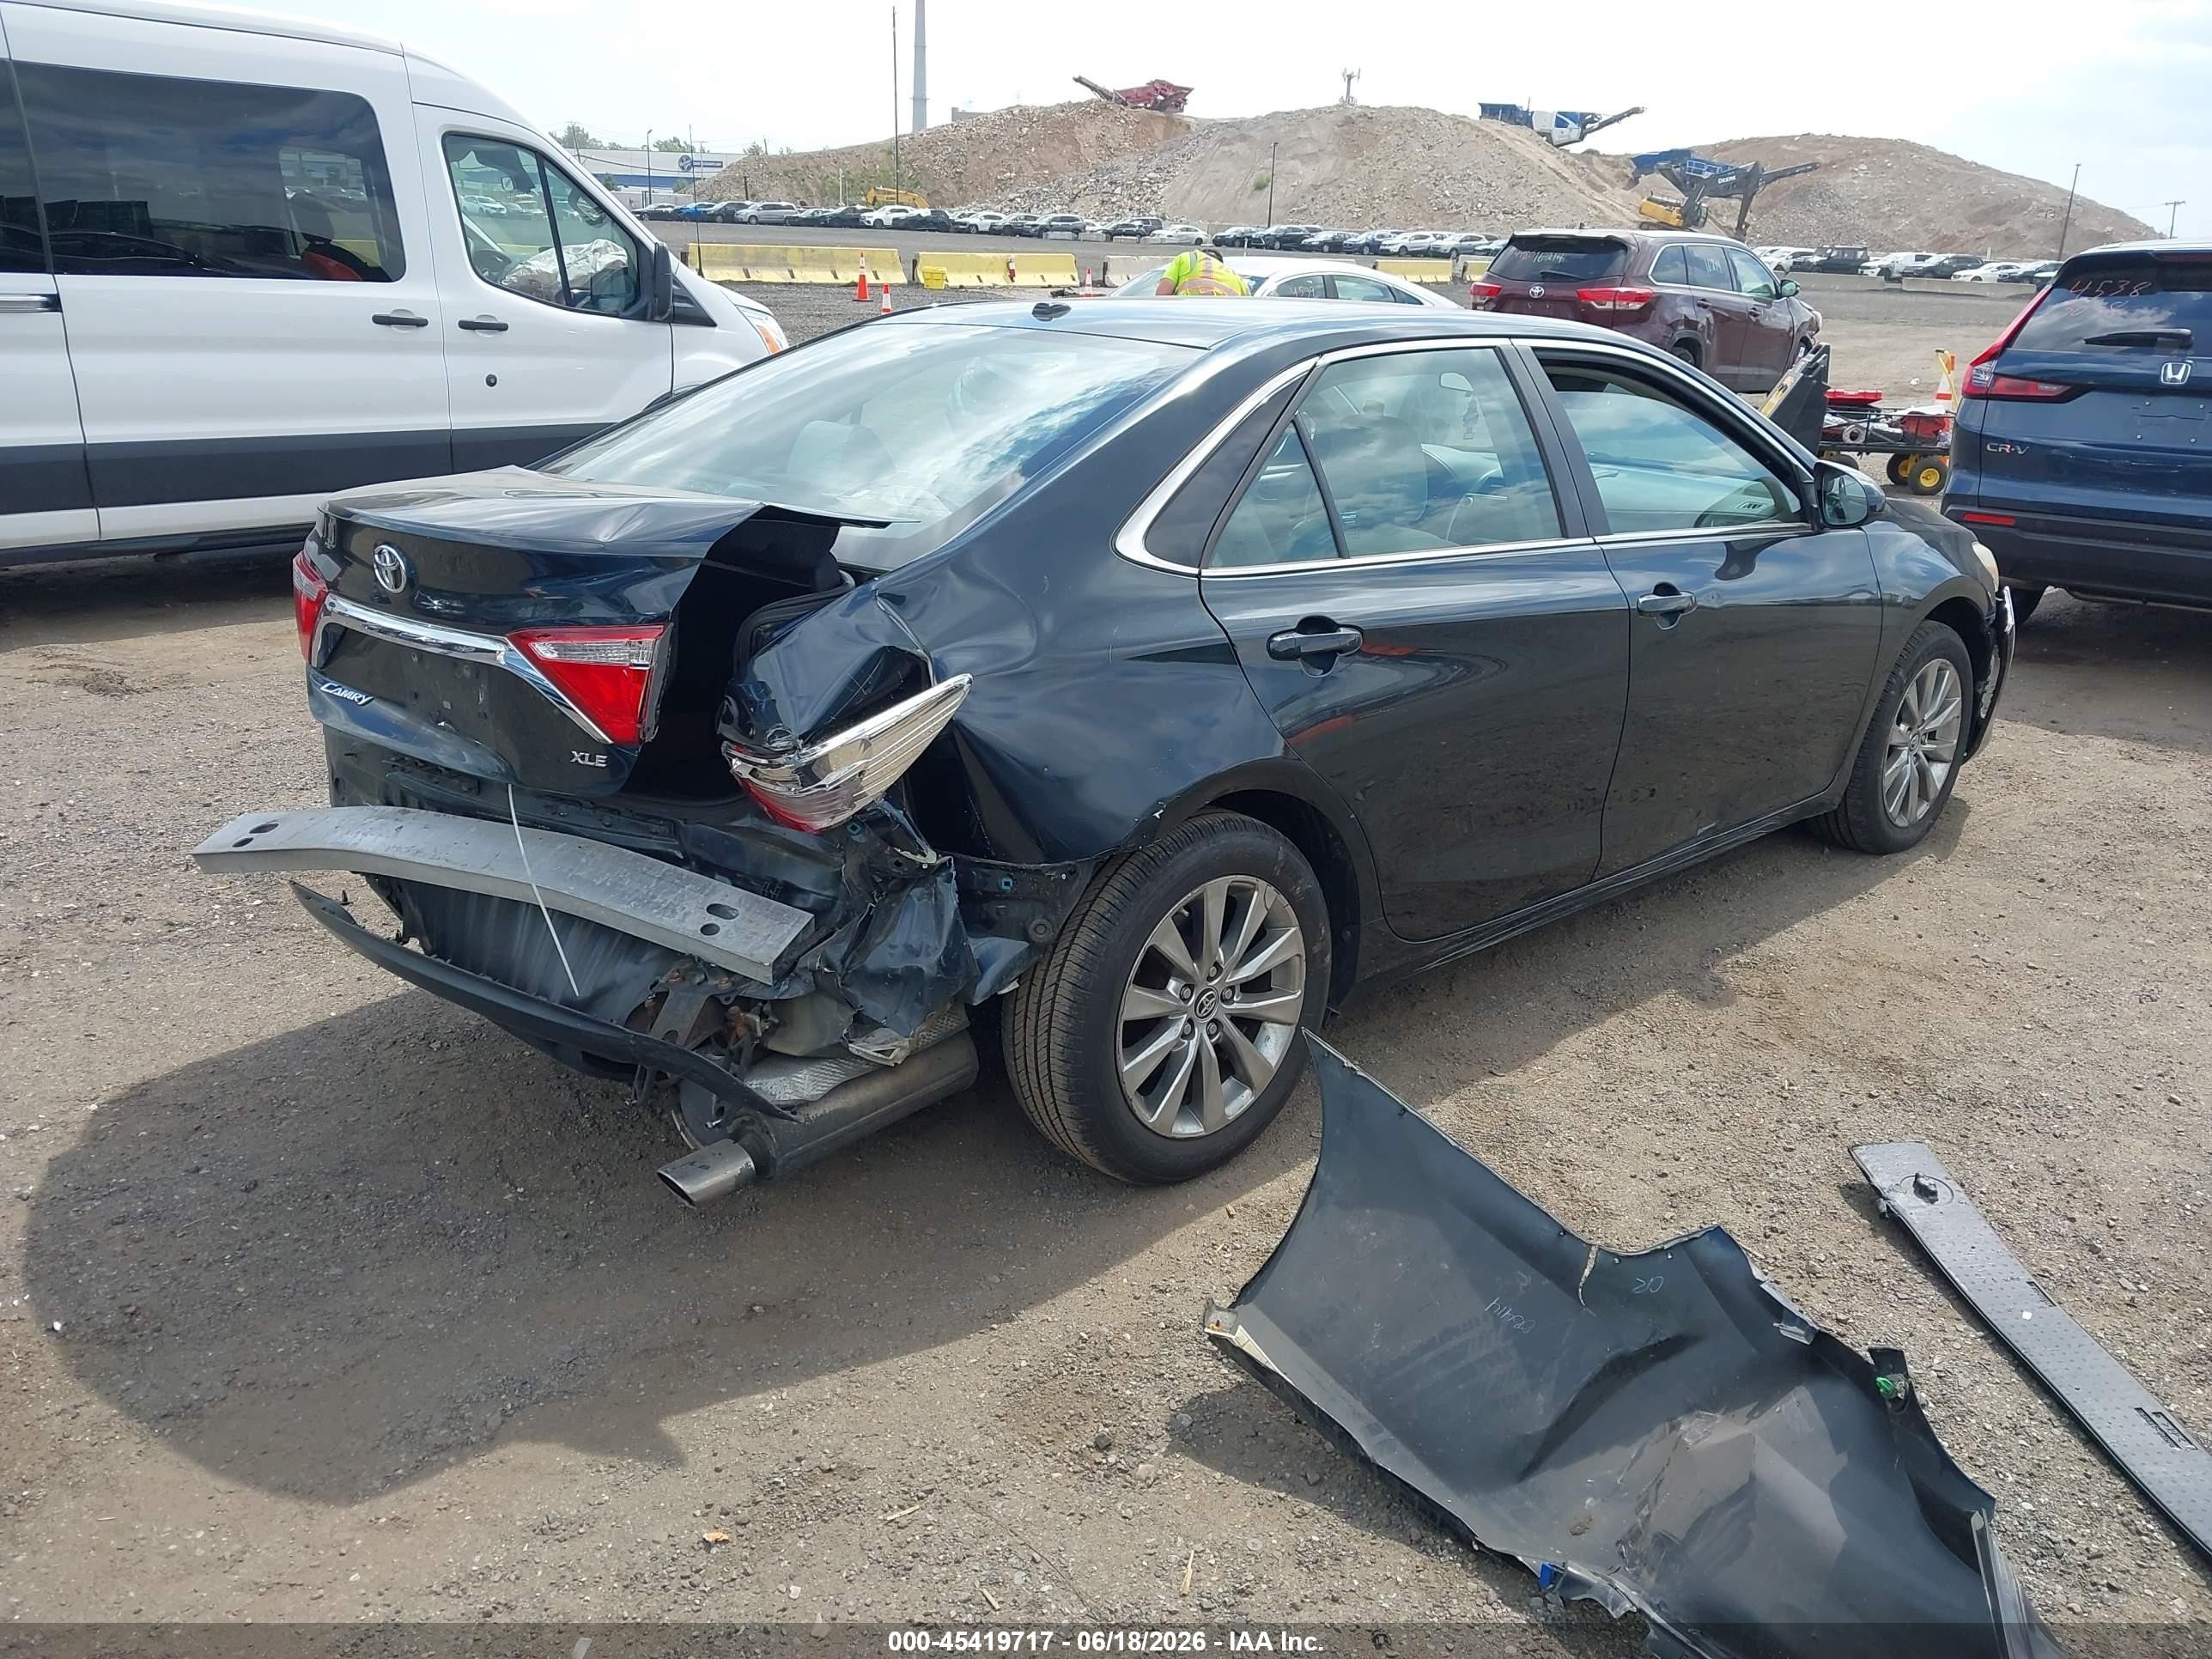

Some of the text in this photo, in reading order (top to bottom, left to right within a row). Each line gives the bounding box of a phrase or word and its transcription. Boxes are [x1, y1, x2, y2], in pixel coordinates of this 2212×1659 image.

[2069, 280, 2152, 299] 4538
[1986, 442, 2030, 455] CR-V
[569, 750, 608, 768] XLE
